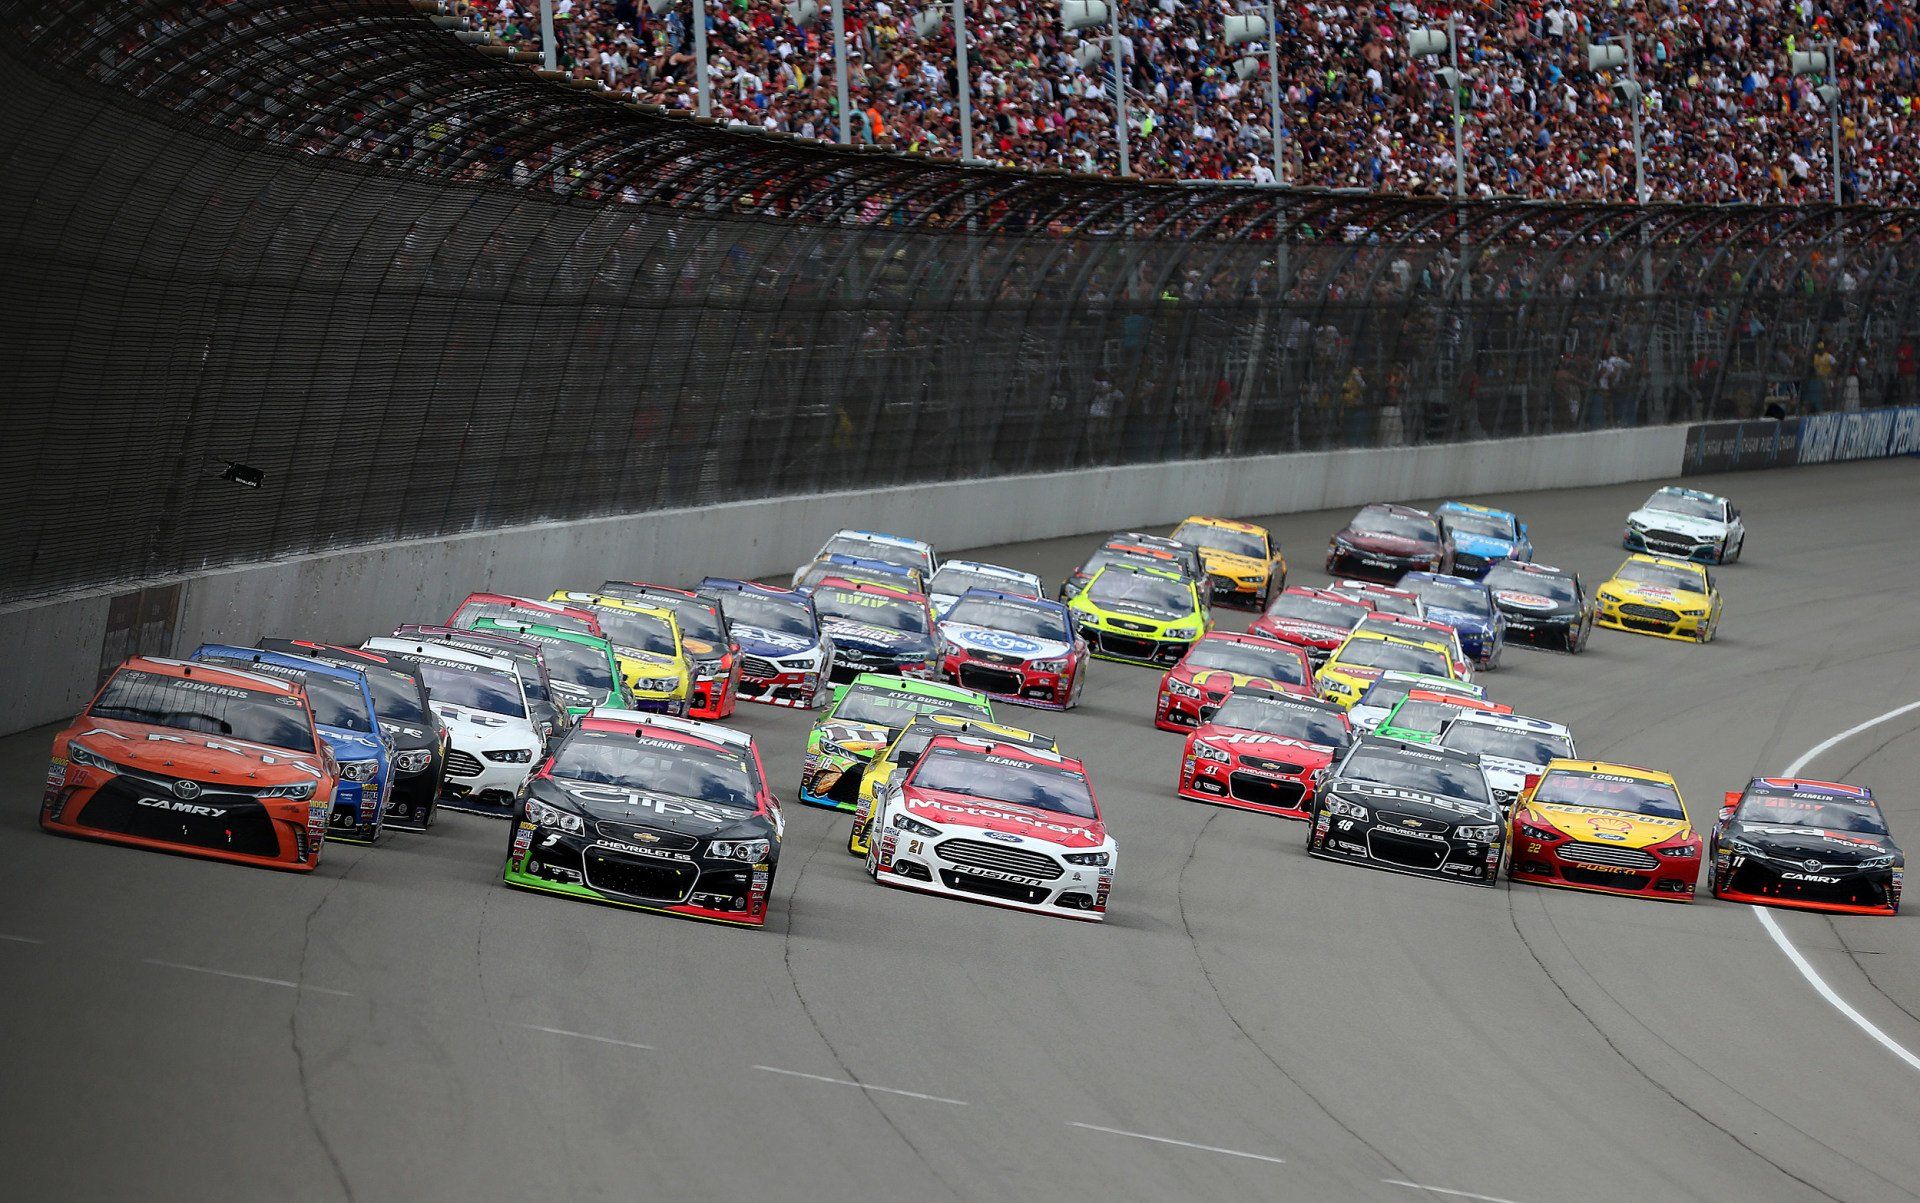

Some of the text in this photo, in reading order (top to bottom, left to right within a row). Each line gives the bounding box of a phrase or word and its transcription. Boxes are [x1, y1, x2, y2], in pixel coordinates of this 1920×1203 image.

[635, 593, 683, 604] STEWART
[508, 607, 552, 619] LARSON
[601, 606, 638, 617] DILLON
[520, 633, 562, 645] DILLON
[969, 629, 1037, 650] Kroger
[252, 662, 307, 677] GORDON
[400, 654, 478, 673] KESELOWSKI
[173, 680, 249, 699] EDWARDS
[888, 691, 954, 707] KYLE BUSCH
[1175, 701, 1182, 710] 1
[1256, 697, 1318, 713] KURT BUSCH
[1495, 726, 1528, 736] RAGAN
[638, 738, 686, 752] KAHNE
[985, 755, 1034, 769] BLANEY
[1397, 749, 1443, 762] JOHNSON
[820, 757, 834, 770] 18
[1204, 765, 1219, 775] 41
[70, 768, 89, 785] 19
[1590, 773, 1635, 785] LOGANO
[1791, 792, 1834, 802] HAMLIN
[137, 797, 227, 818] CAMRY
[908, 798, 1097, 842] Motorcraft
[1545, 805, 1679, 827] PENNZOIL
[1337, 819, 1354, 832] 48
[1376, 823, 1430, 839] CHEVROLET
[542, 833, 562, 847] 5
[909, 839, 925, 855] 21
[1822, 836, 1887, 854] Express
[596, 839, 673, 859] CHEVROLET
[1527, 842, 1542, 854] 22
[1732, 855, 1746, 868] 11
[951, 864, 1043, 886] FUSION
[1781, 872, 1842, 884] CAMRY
